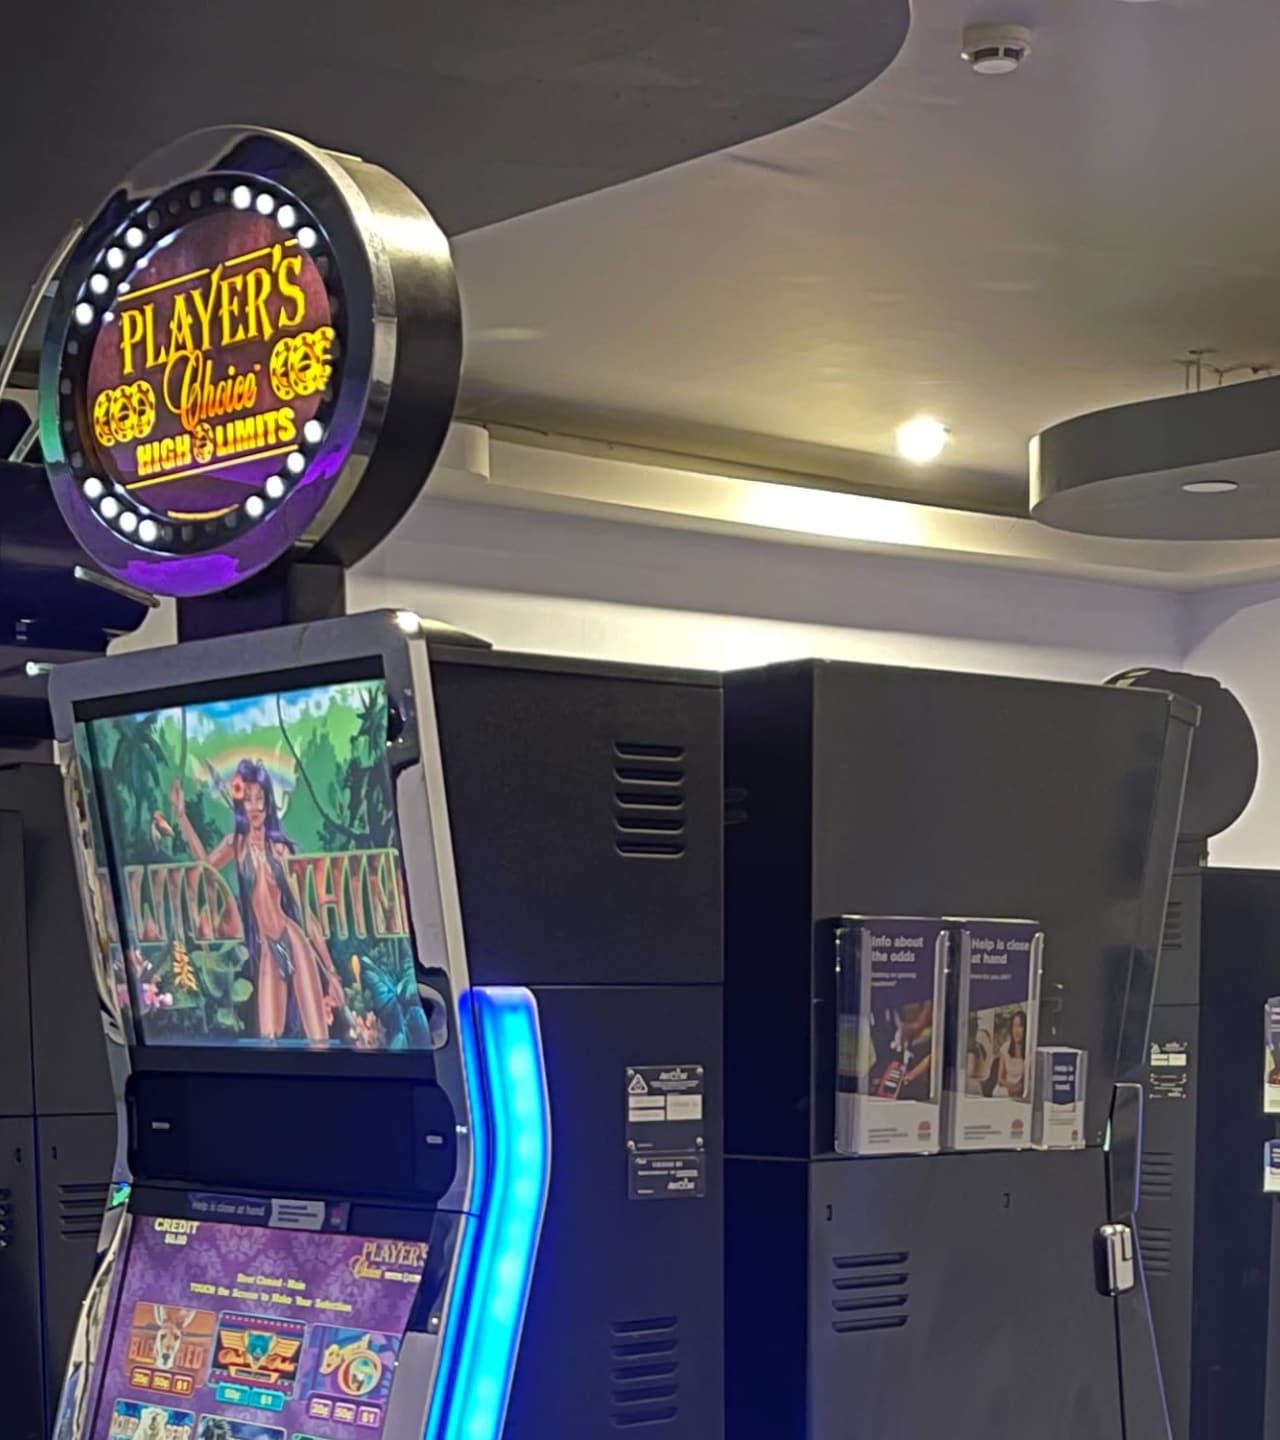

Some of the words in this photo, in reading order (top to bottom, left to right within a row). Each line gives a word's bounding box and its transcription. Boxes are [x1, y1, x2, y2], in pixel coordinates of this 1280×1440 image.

[121, 244, 305, 375] PLAYER'S
[163, 350, 257, 432] Choice
[136, 436, 191, 475] HIGH
[214, 407, 296, 455] LIMITS
[280, 849, 410, 939] THIN
[871, 936, 891, 947] Info
[894, 936, 923, 948] about
[971, 938, 994, 951] Help
[1007, 939, 1029, 951] close
[872, 951, 887, 962] the
[890, 951, 915, 962] odds
[983, 953, 1007, 964] hand
[154, 1217, 200, 1234] CREDIT
